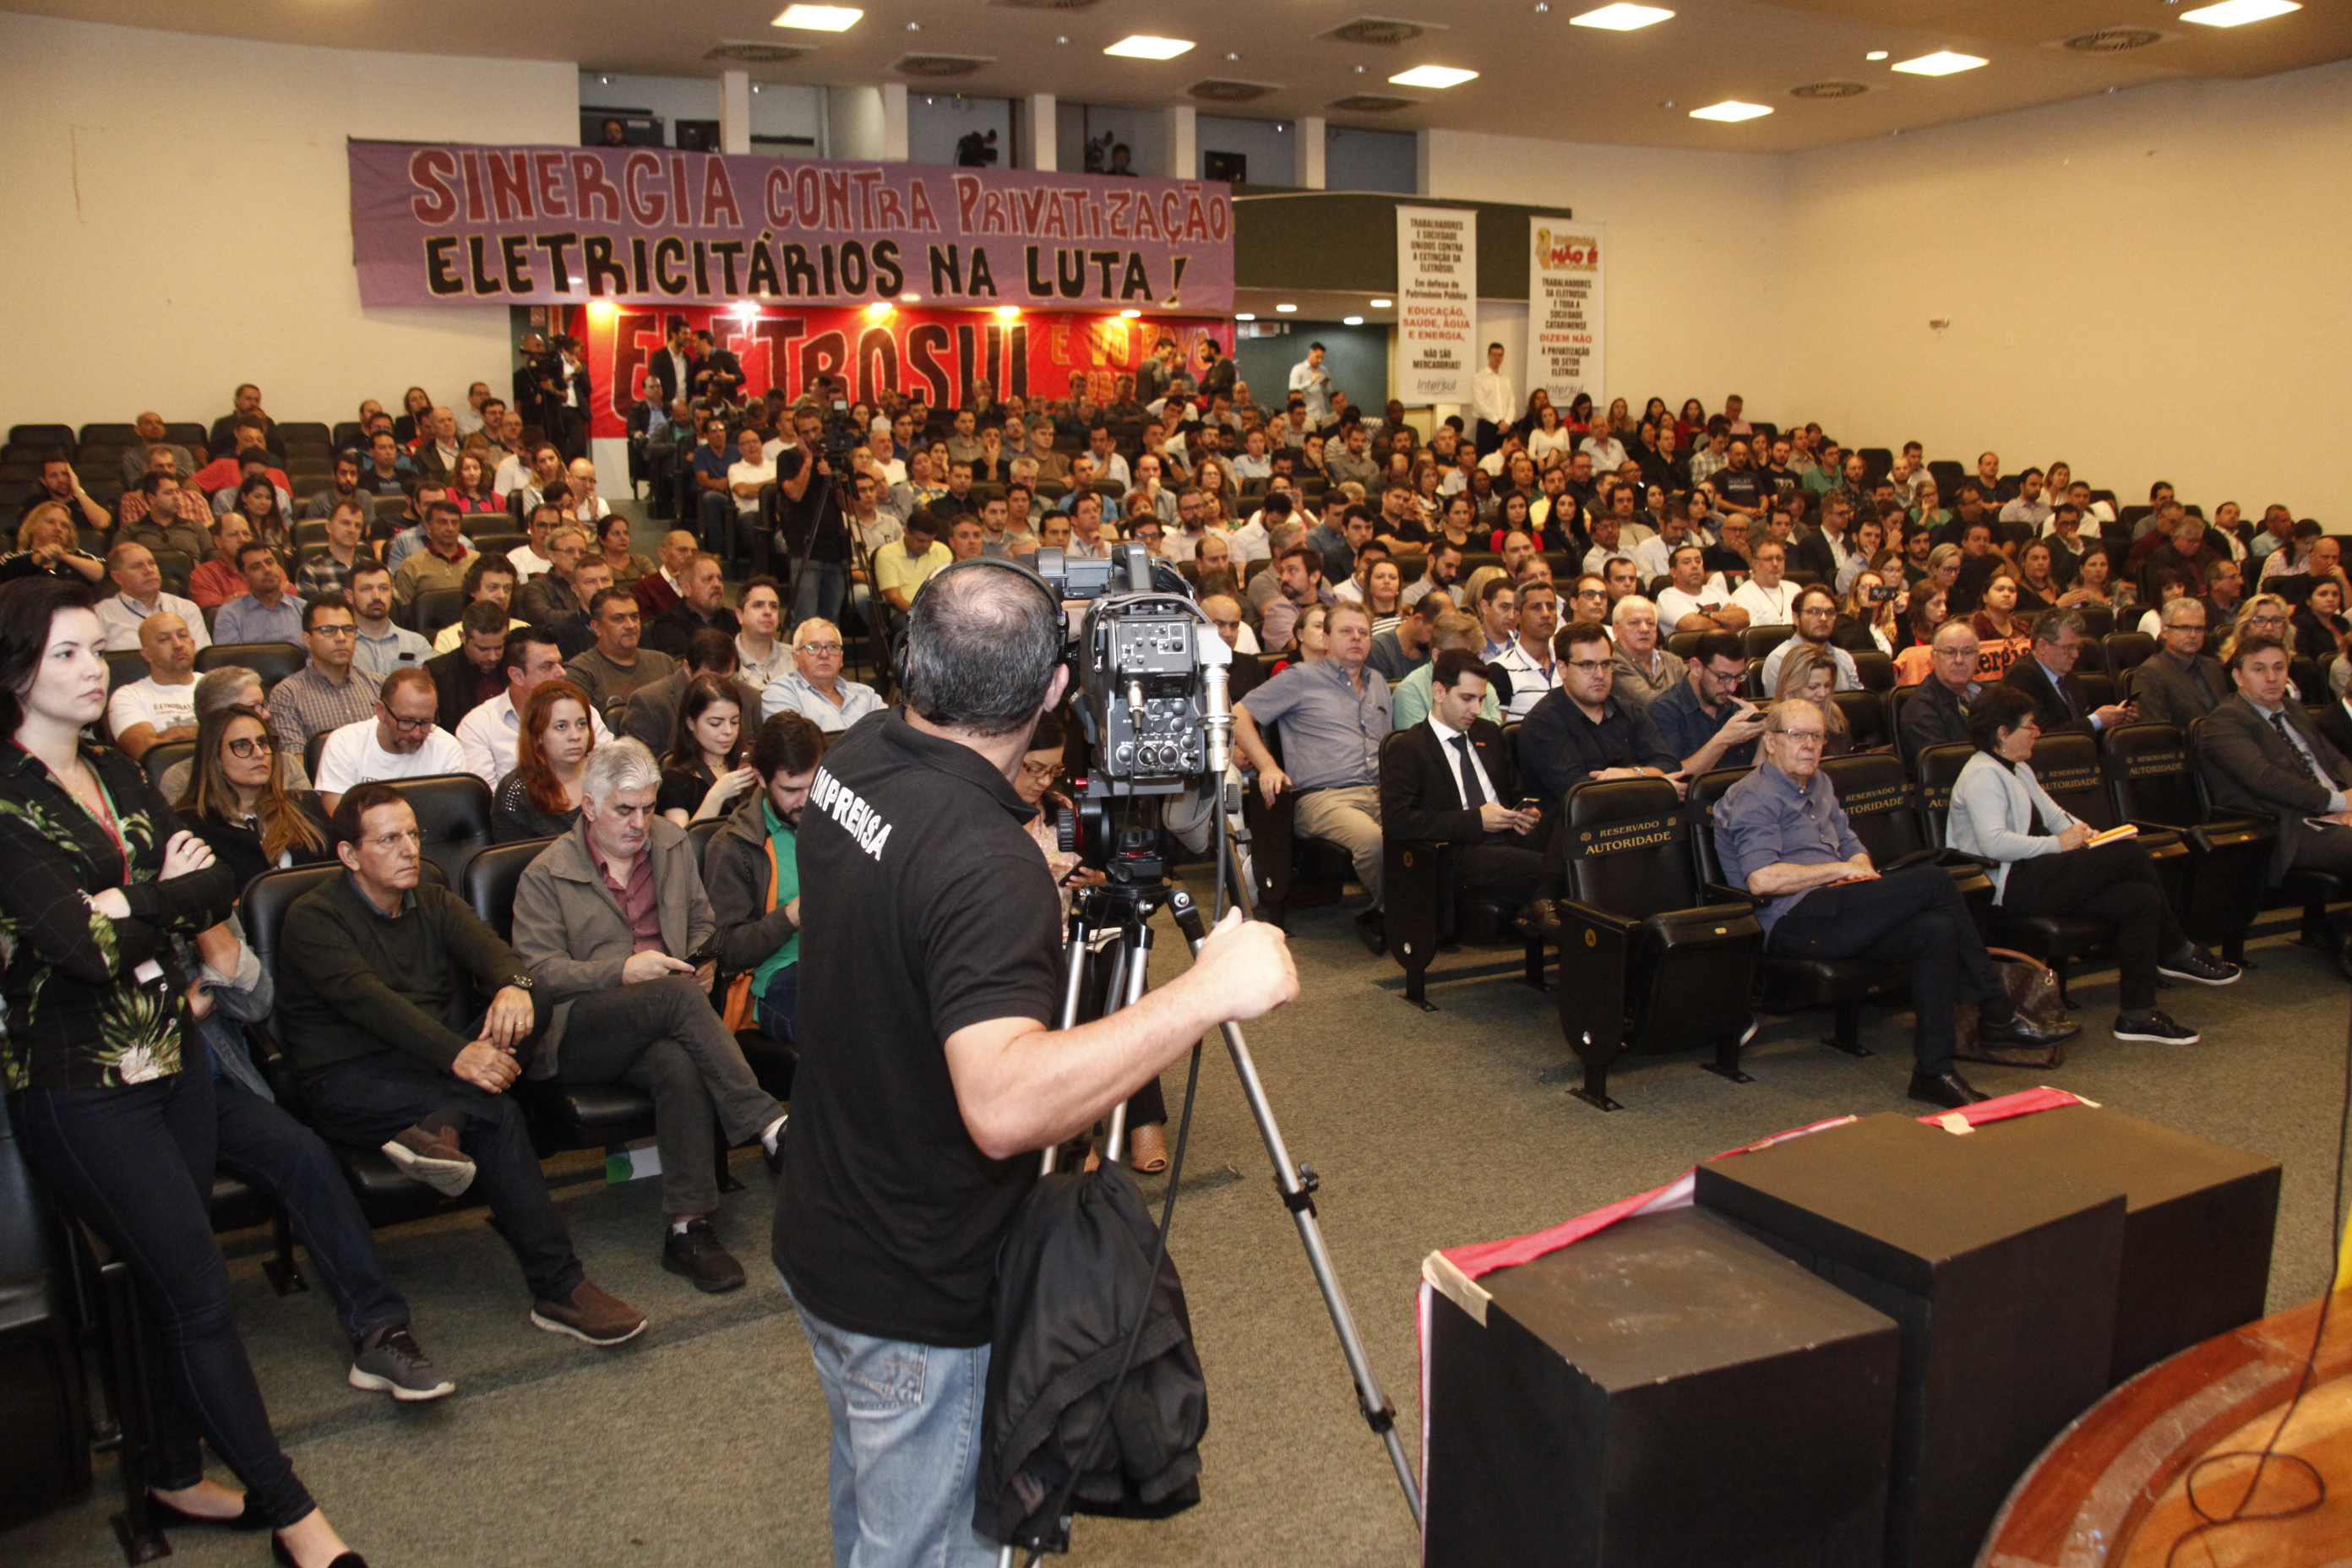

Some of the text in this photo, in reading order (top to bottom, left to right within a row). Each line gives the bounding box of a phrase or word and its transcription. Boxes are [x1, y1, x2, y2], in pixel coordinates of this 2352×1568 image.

[409, 149, 1230, 247] SINERGIA CONTRA PRIVATIZAÇÃO
[1410, 218, 1463, 231] TRABALHADORES
[1423, 230, 1456, 241] SOCIEDADE
[1410, 241, 1463, 253] UNIDOS CONTRA
[1452, 253, 1462, 263] DA
[1551, 243, 1584, 264] NÃO
[423, 227, 905, 301] ELETRICITÁRIOS
[928, 243, 999, 299] NA
[1415, 278, 1425, 288] Em
[1545, 288, 1554, 298] DA
[1559, 300, 1575, 309] TODA
[1550, 310, 1583, 320] SOCIEDADE
[1443, 318, 1471, 329] ÁGUA
[1545, 320, 1587, 330] CATARINENSE
[1408, 330, 1465, 342] E ENERGIA,
[1539, 333, 1593, 344] DIZEM NÃO
[1424, 348, 1451, 359] NÃO SÃO
[610, 309, 1029, 421] EETROSUL
[1551, 357, 1581, 367] DO SETOR
[2137, 753, 2175, 763] RESERVADO
[2049, 767, 2091, 778] RESERVADO
[2129, 763, 2184, 776] AUTORIDADE
[2041, 777, 2099, 792] AUTORIDADE
[1845, 787, 1896, 803] RESERVADO
[1843, 796, 1904, 815] UTORIDADE
[809, 765, 892, 862] IMPRENSA
[1599, 820, 1660, 837] RESERVADO
[1585, 831, 1672, 855] AUTORIDADE
